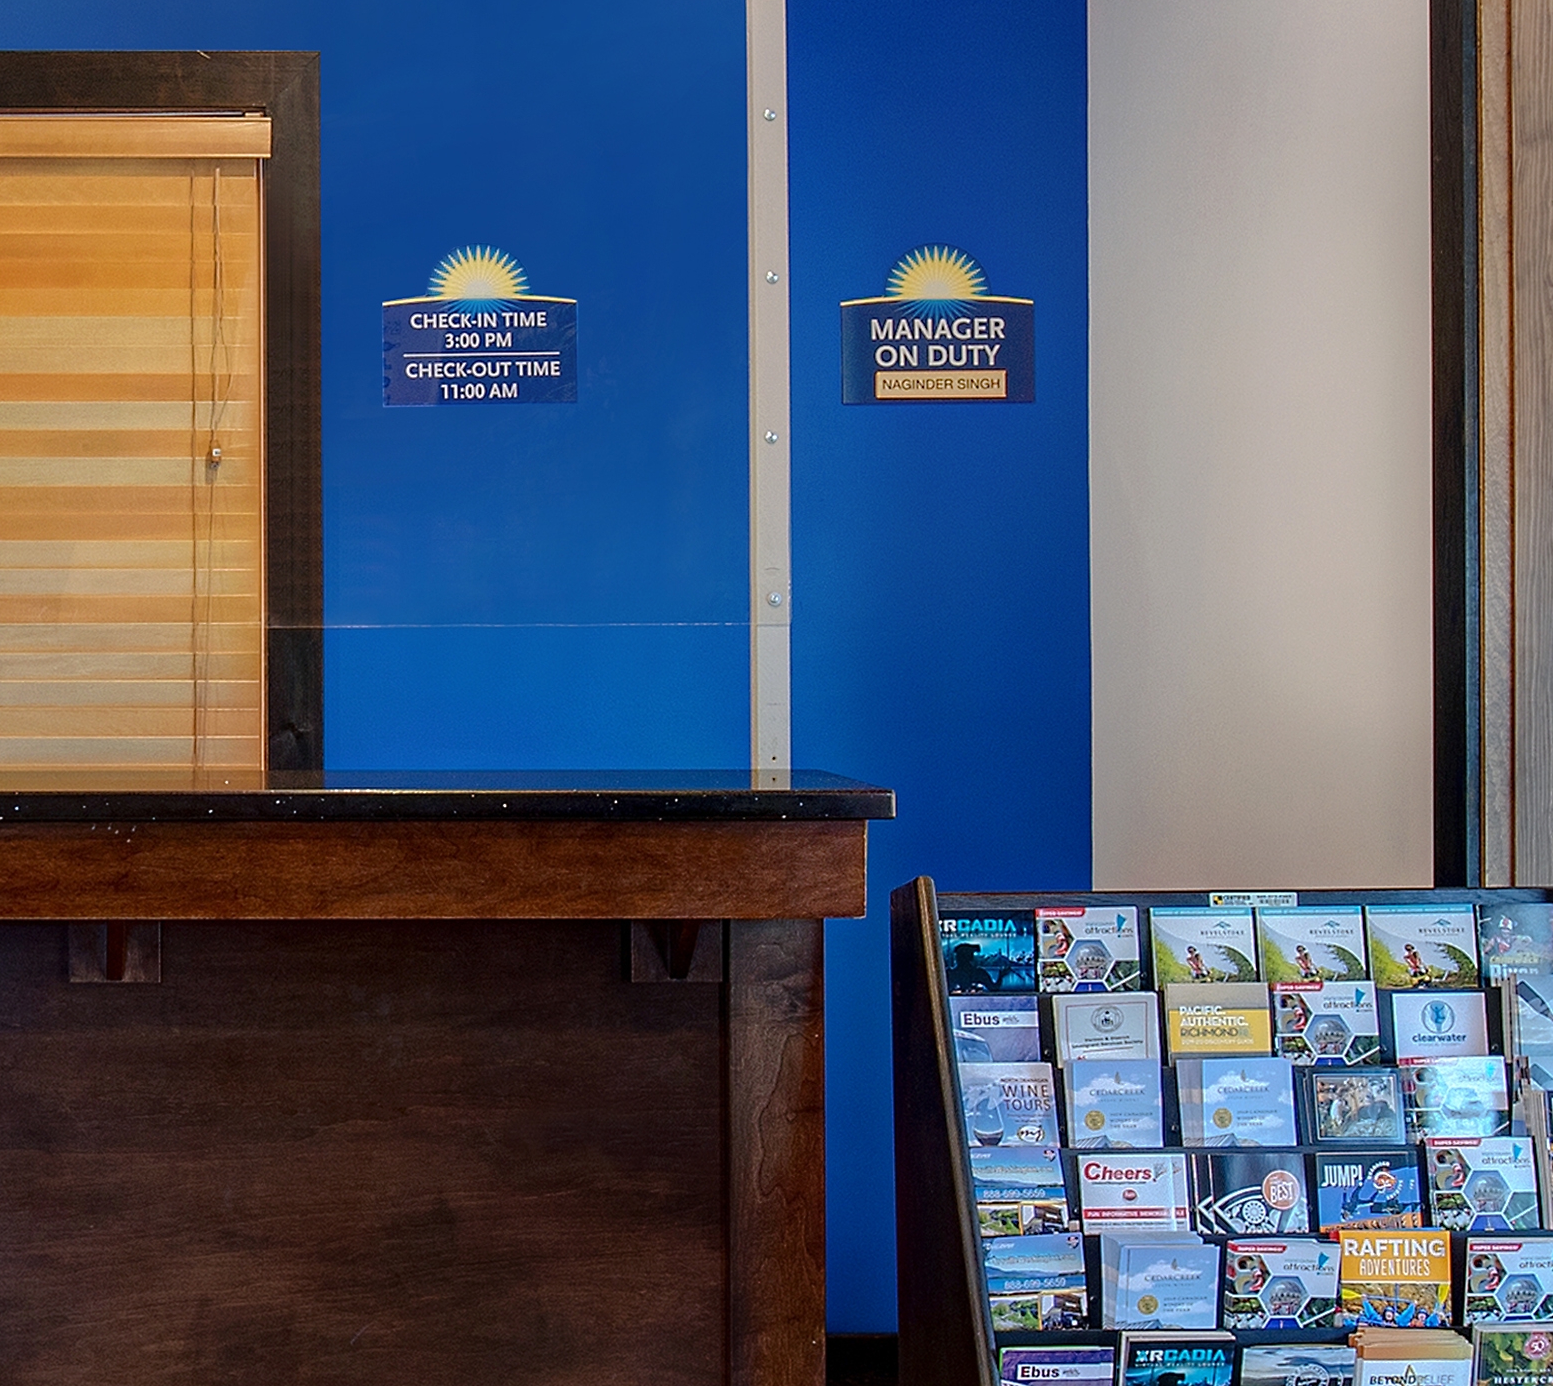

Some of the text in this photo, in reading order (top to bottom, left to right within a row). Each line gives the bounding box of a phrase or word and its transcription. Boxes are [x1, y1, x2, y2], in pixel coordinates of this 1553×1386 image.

[410, 312, 547, 328] CHECK-IN TIME
[871, 318, 1005, 340] MANAGER
[445, 333, 512, 348] 3:00 PM
[875, 344, 1001, 367] ON DUTY
[406, 361, 561, 378] CHECK-OUT TIME
[882, 379, 1000, 390] NAGINDER SINGH
[441, 383, 518, 399] 11:00 AM
[1179, 1006, 1226, 1015] PACIFIC.
[963, 1014, 1000, 1026] Ebus
[1180, 1016, 1248, 1026] AUTHENTIC.
[1412, 1033, 1467, 1043] clearwater
[1002, 1085, 1048, 1097] WINE
[1089, 1089, 1145, 1097] CEDARCREEK
[1003, 1099, 1051, 1111] TOURS
[1322, 1165, 1363, 1187] JUMP!
[1270, 1182, 1293, 1204] BEST
[1344, 1239, 1445, 1257] RAFTING
[1283, 1264, 1334, 1273] attractions
[1359, 1259, 1430, 1277] ADVENTURES
[1531, 1341, 1546, 1351] 50
[1135, 1349, 1225, 1362] XRCADIA
[1020, 1366, 1060, 1378] Ebus
